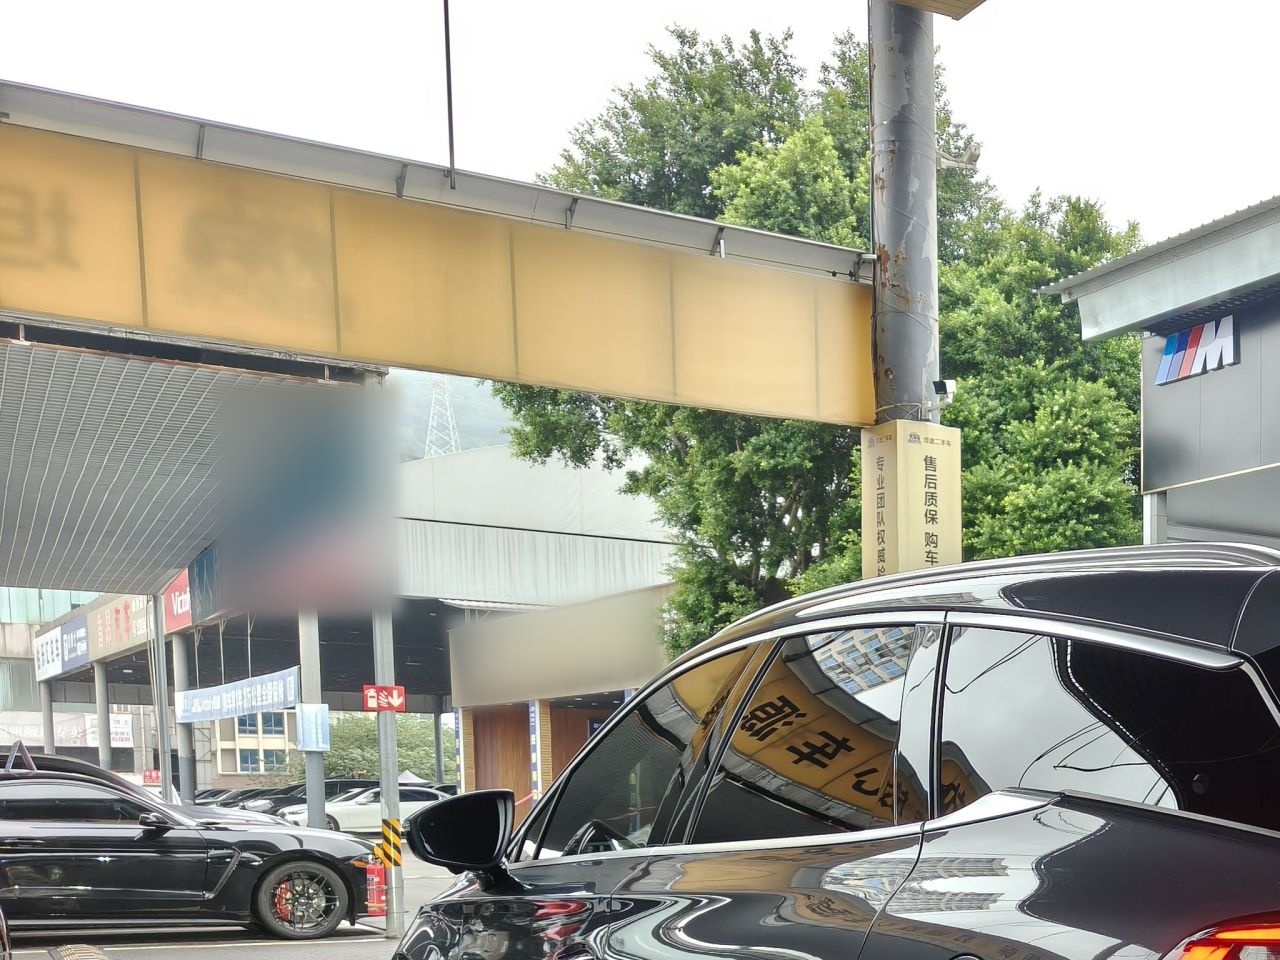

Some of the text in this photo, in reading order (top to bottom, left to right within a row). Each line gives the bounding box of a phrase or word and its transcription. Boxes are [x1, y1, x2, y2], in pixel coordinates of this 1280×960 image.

[923, 454, 939, 567] 售后质保 购车
